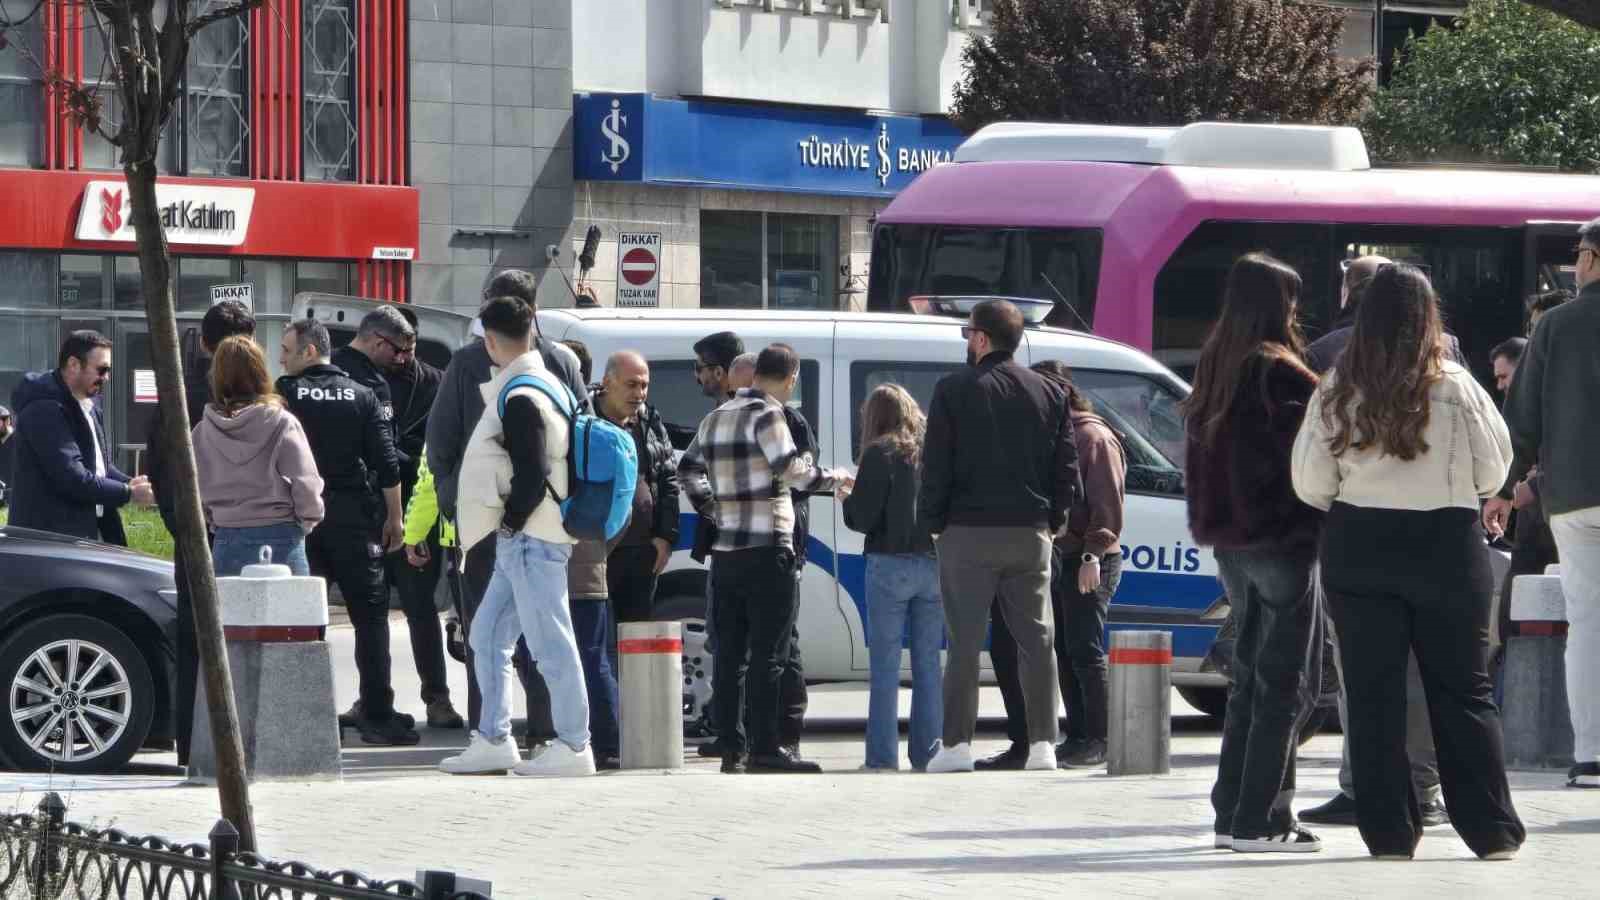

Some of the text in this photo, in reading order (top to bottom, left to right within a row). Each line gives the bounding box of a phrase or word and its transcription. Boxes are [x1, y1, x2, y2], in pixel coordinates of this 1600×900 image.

[799, 135, 870, 168] TÜRKİYE
[899, 147, 951, 171] BANKA
[183, 200, 236, 230] Katılım
[620, 288, 657, 299] TUZAK VAR
